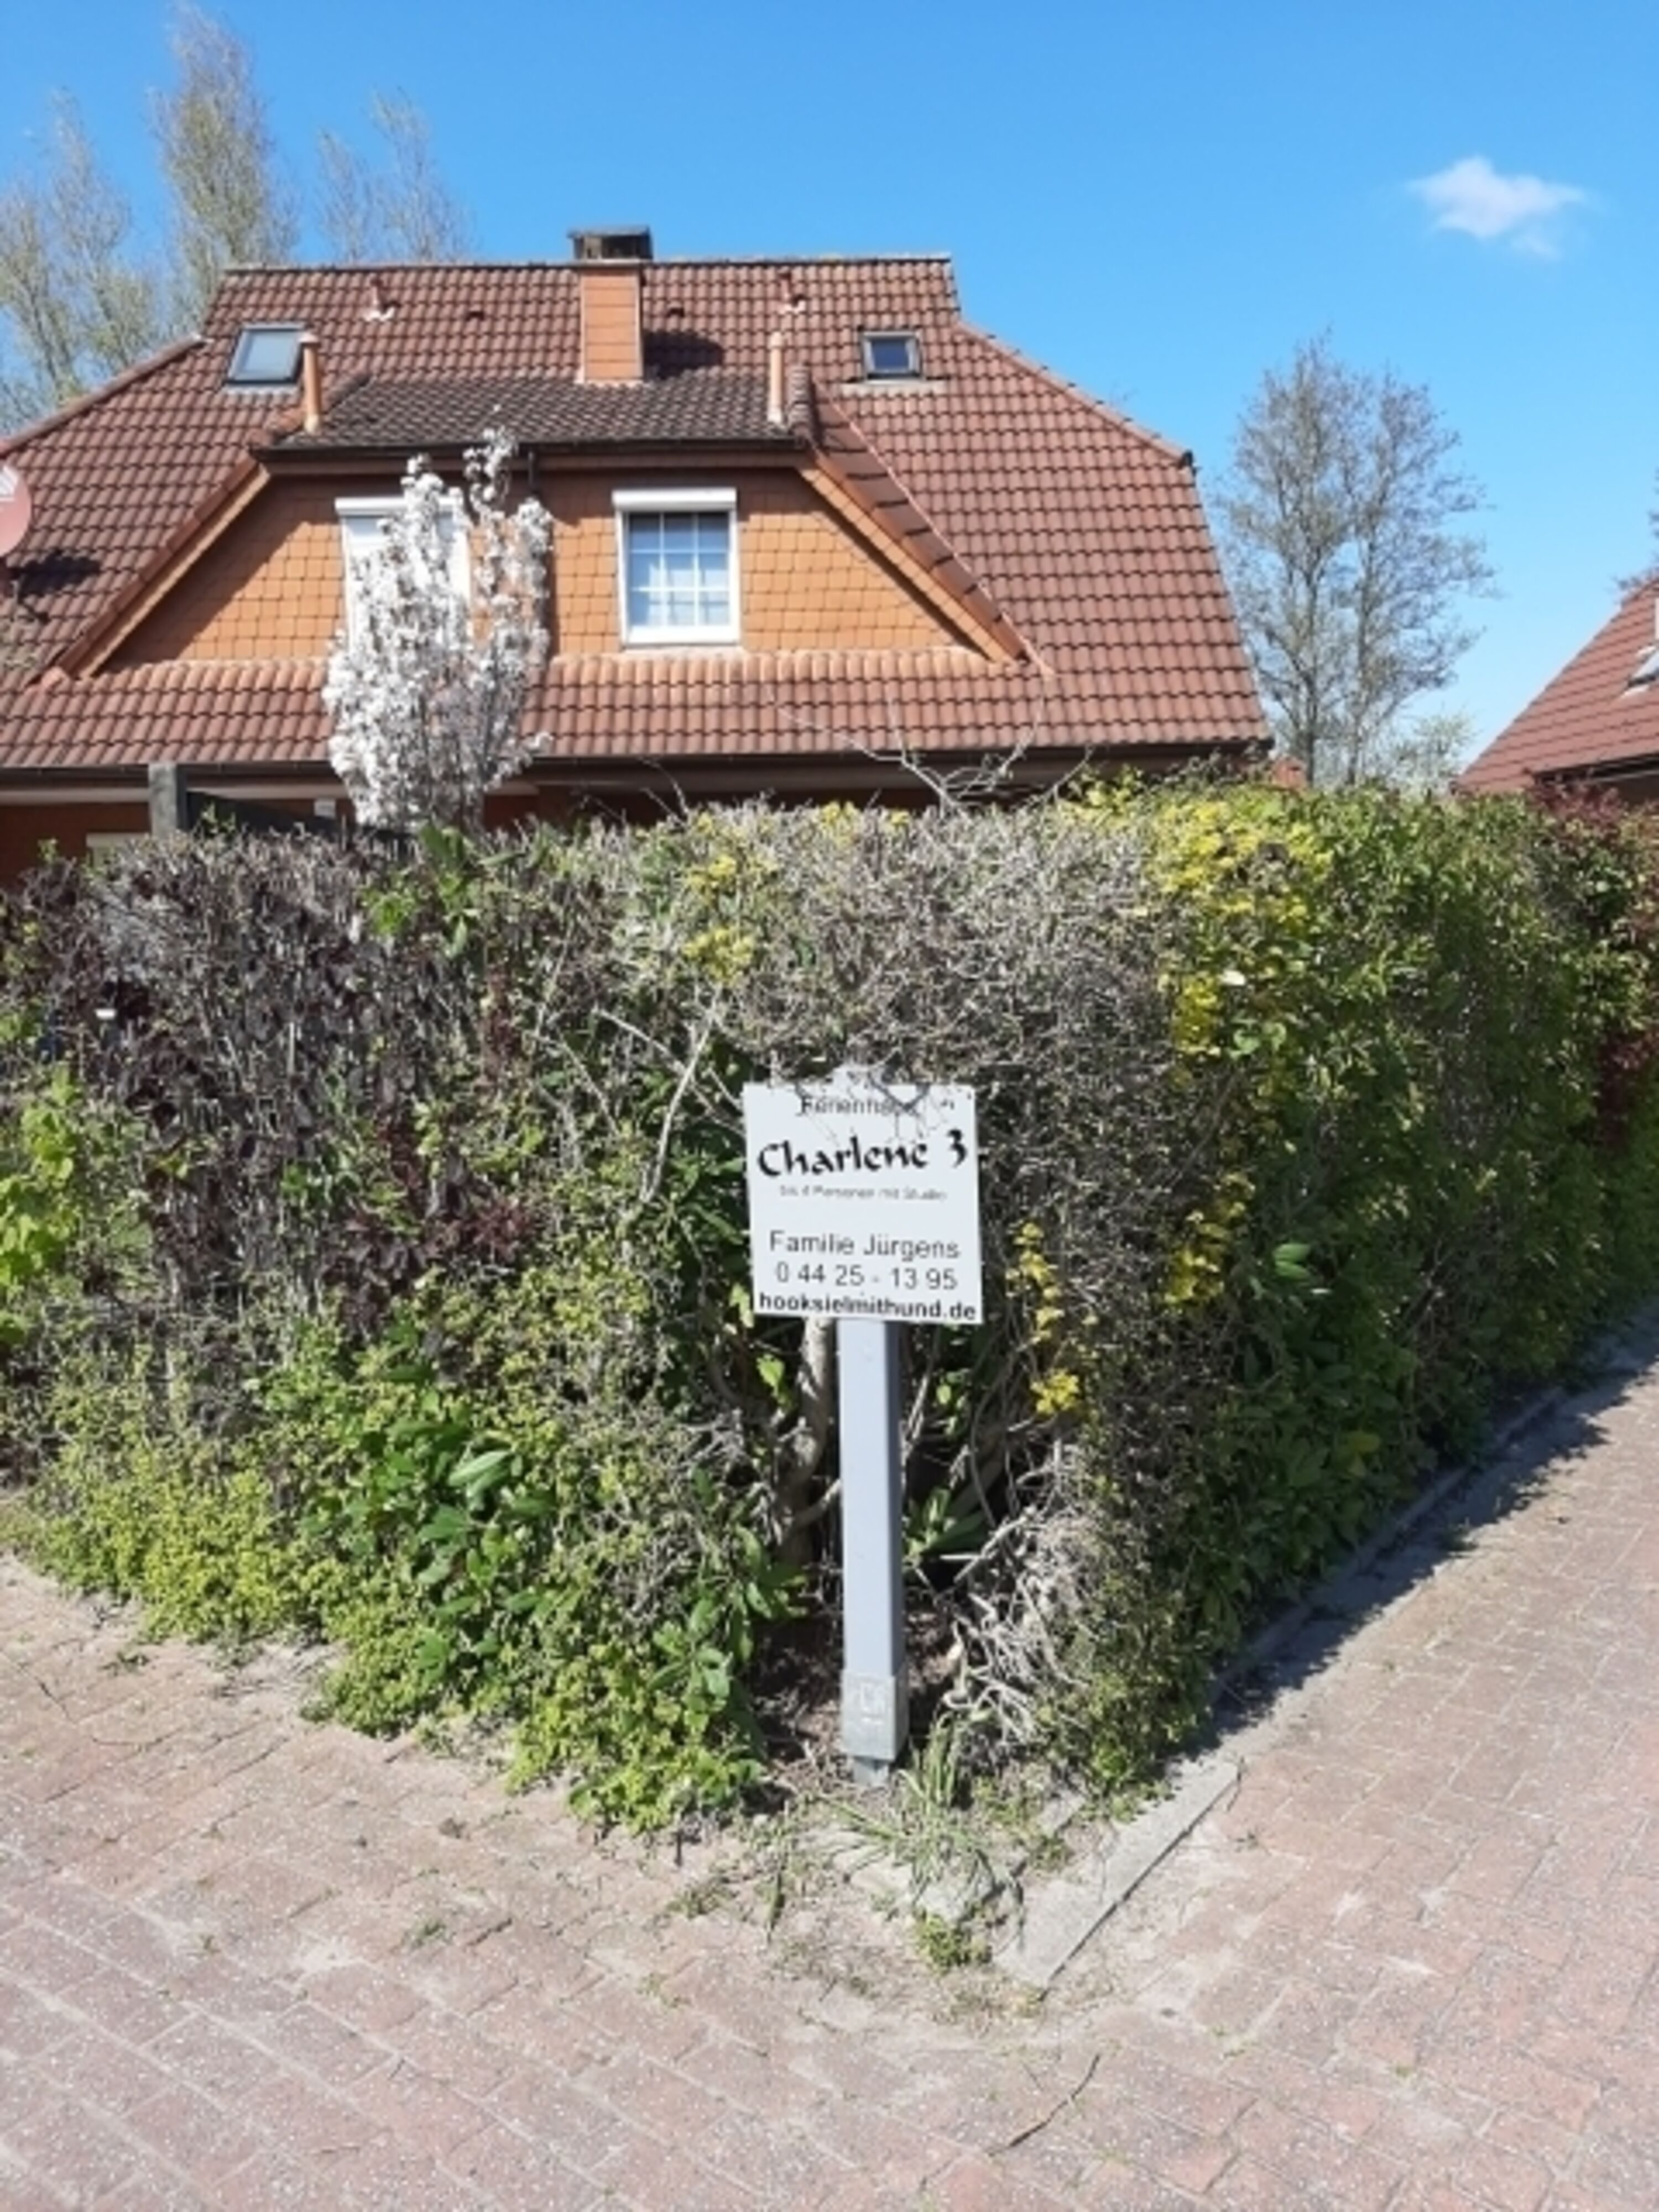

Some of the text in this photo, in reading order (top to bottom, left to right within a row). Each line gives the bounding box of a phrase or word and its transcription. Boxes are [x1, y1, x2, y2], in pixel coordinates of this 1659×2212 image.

[757, 1129, 968, 1177] Charlene 3
[770, 1230, 961, 1261] Familie Jürgens
[775, 1261, 790, 1284] 0
[797, 1264, 826, 1284] 44
[835, 1264, 865, 1287] 25
[891, 1267, 918, 1290] 13
[925, 1268, 958, 1290] 95
[759, 1292, 977, 1320] hooksielmithund.de
